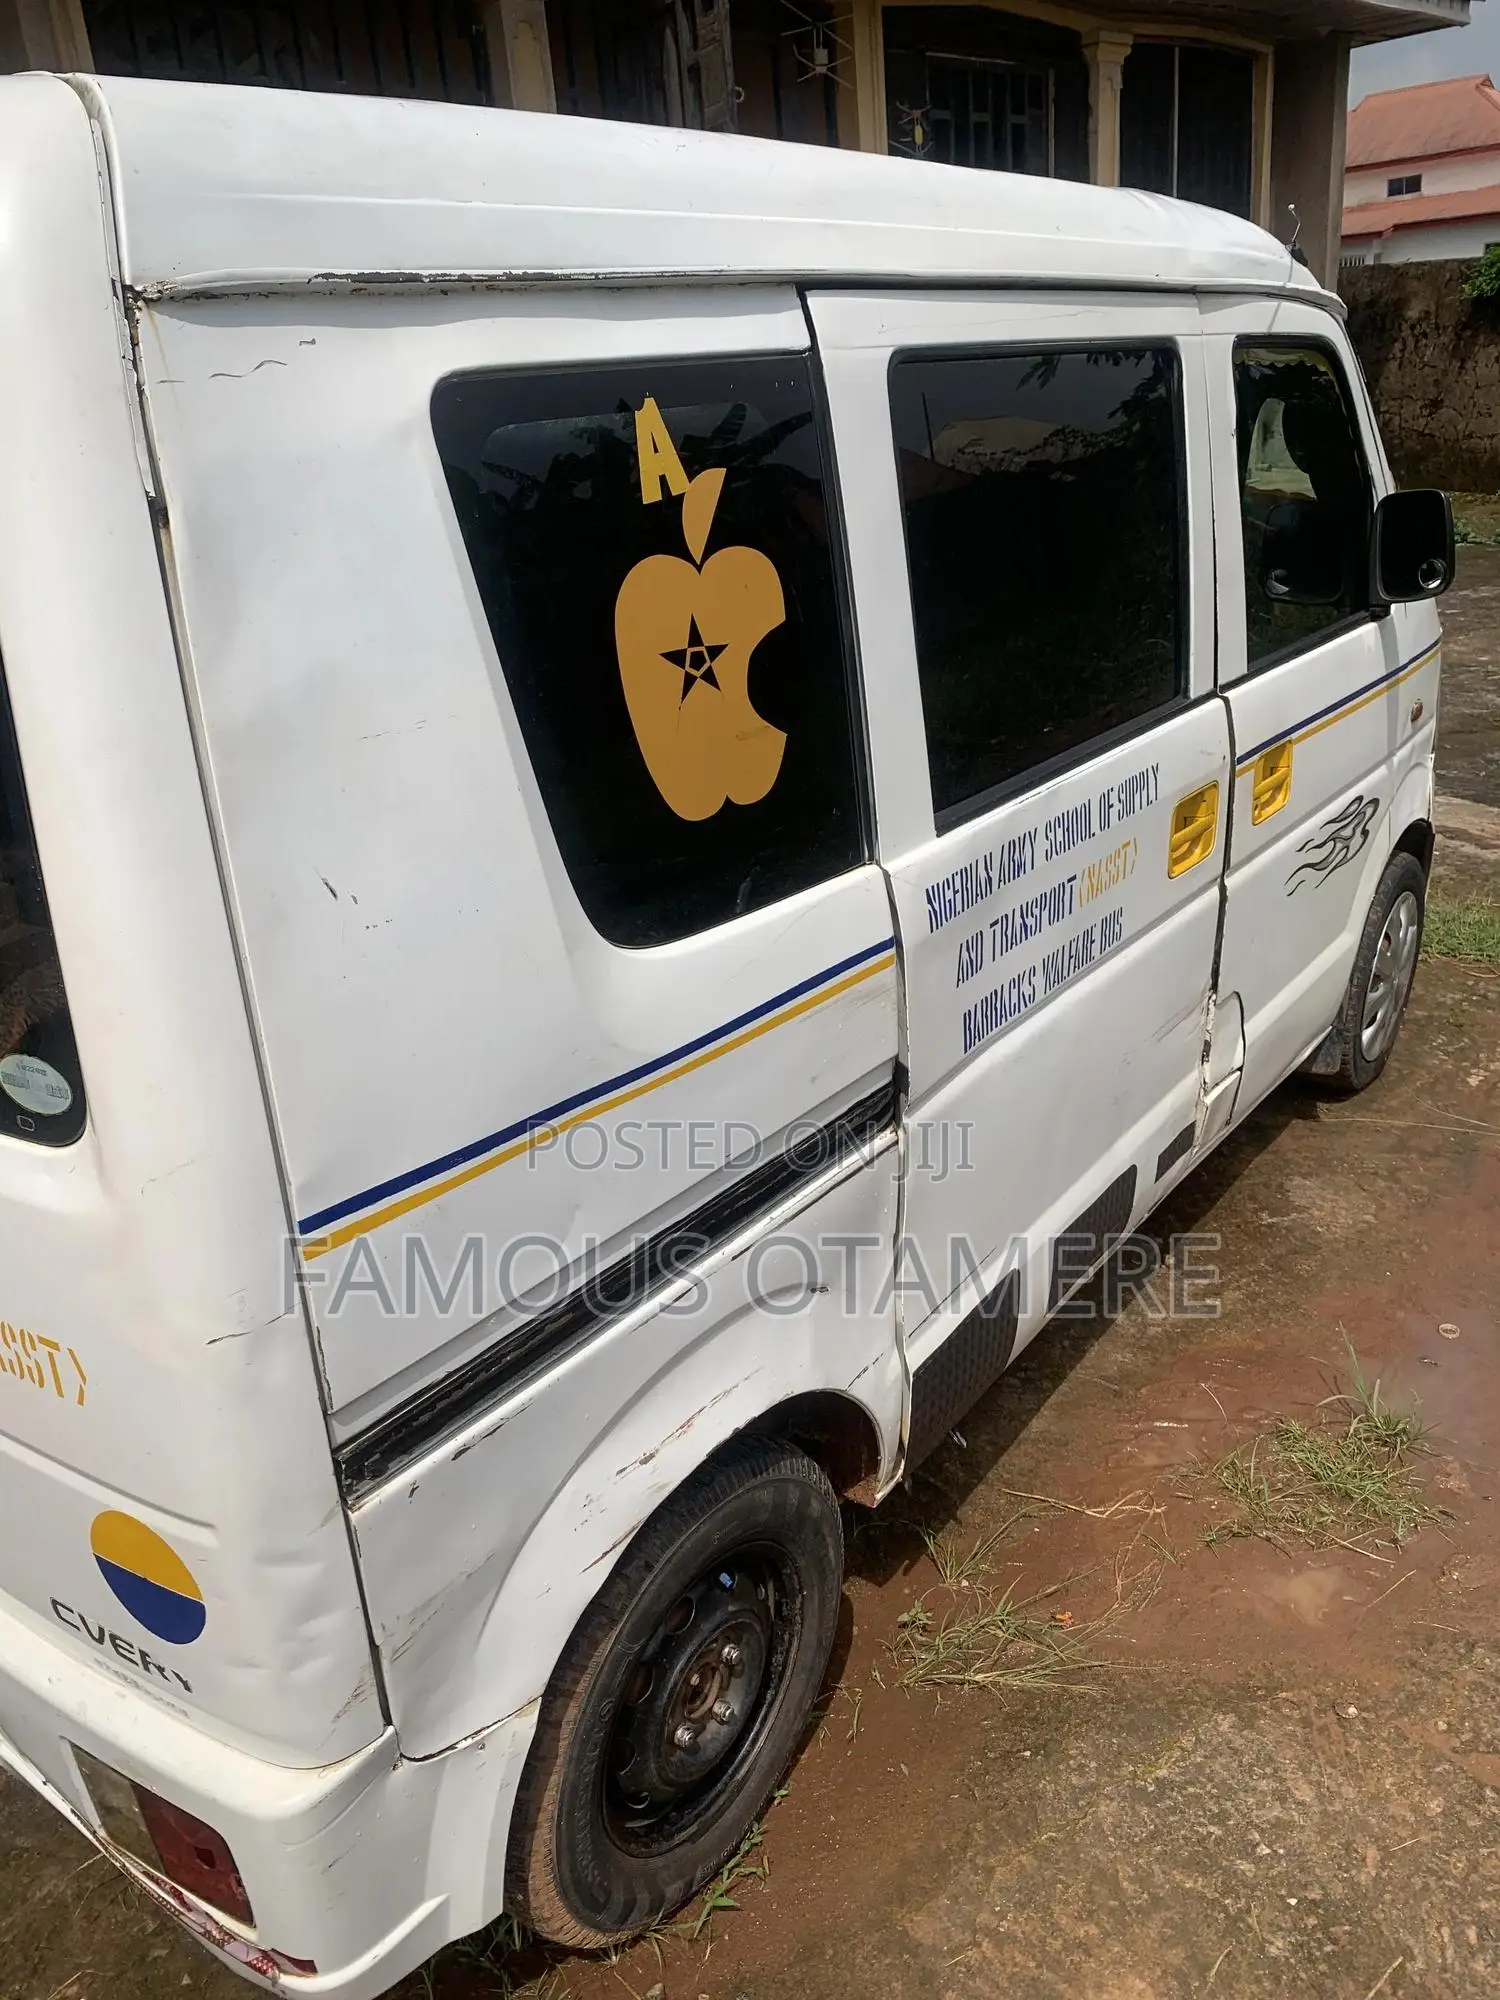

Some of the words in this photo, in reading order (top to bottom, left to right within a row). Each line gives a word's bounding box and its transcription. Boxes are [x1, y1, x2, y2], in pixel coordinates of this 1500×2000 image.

[925, 851, 993, 933] NIGERIAN
[997, 827, 1038, 890] ARMY
[1044, 798, 1096, 862] SCHOOL
[1098, 787, 1114, 832] OF
[1117, 762, 1159, 821] SUPPLY
[956, 929, 984, 988] AND
[989, 874, 1077, 962] TRANSPORT
[963, 965, 1036, 1054] BARRACKS
[1099, 906, 1123, 955] BUS
